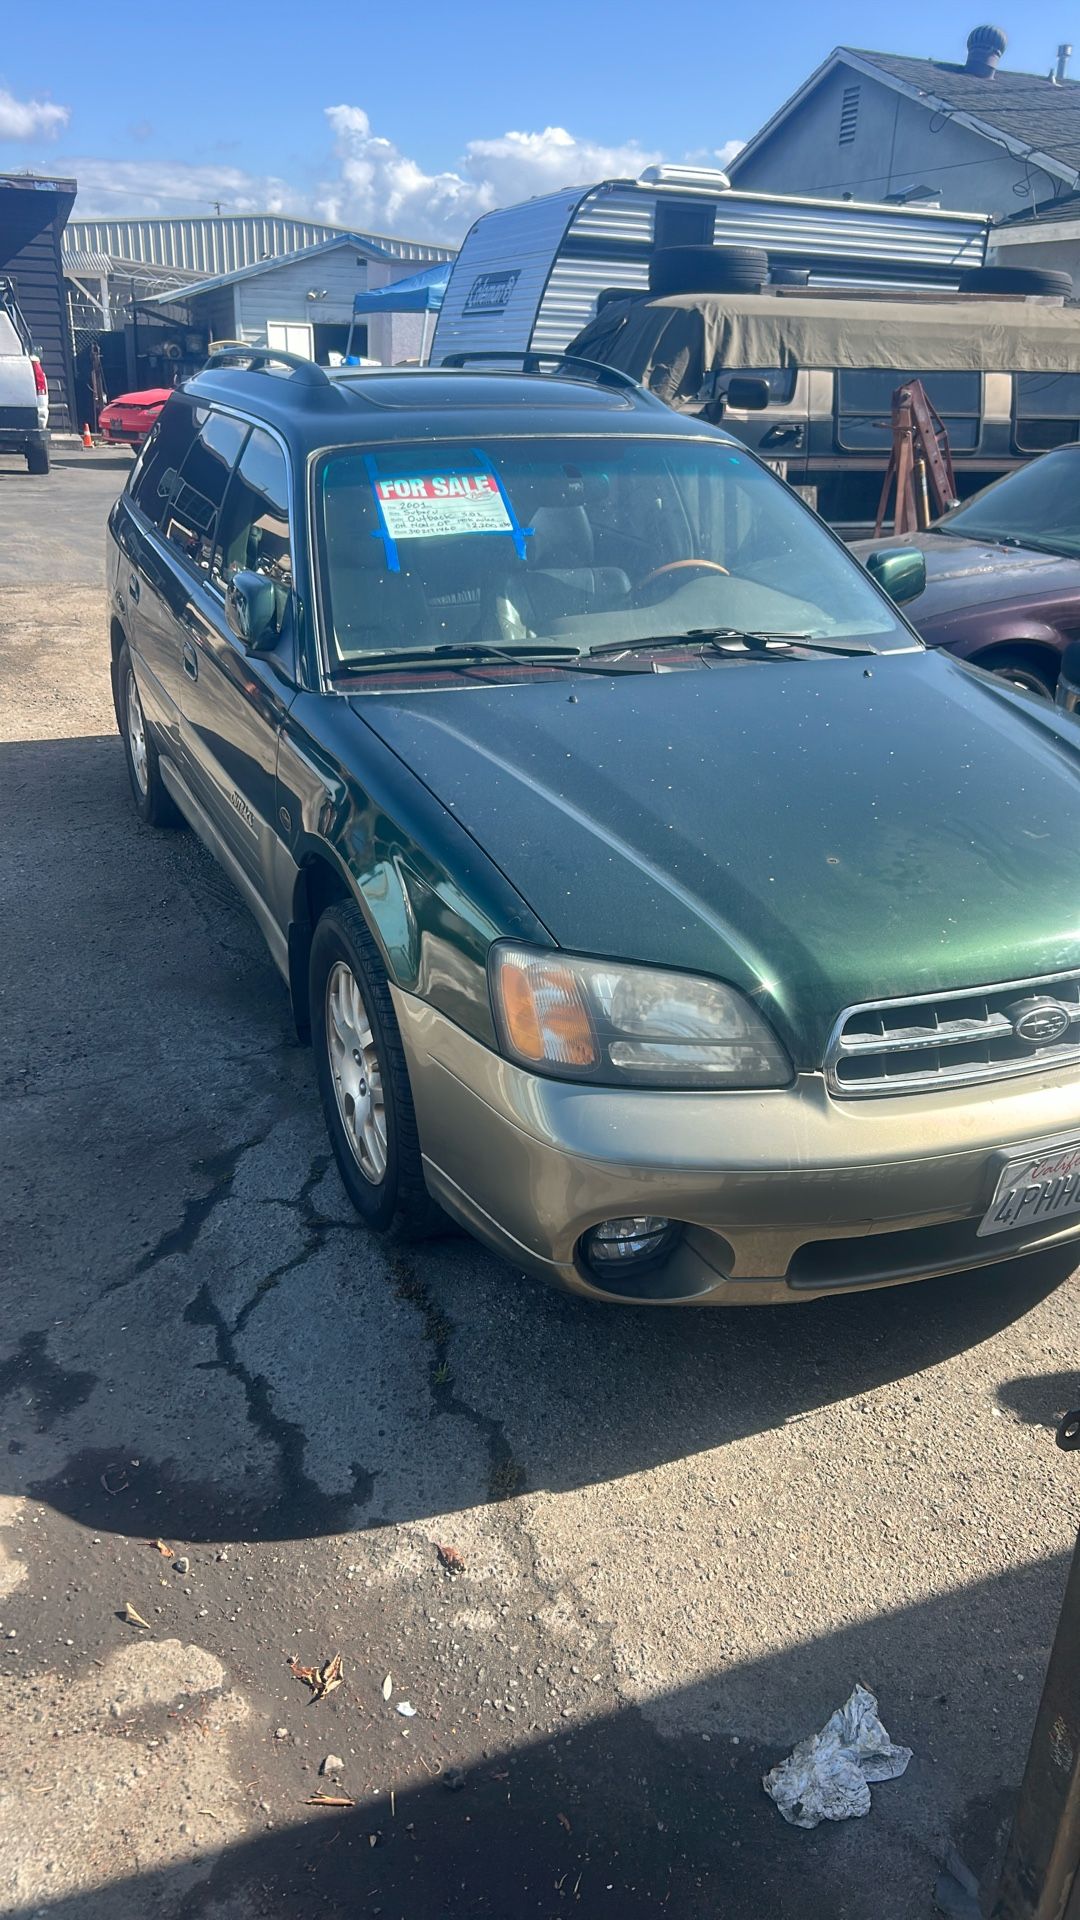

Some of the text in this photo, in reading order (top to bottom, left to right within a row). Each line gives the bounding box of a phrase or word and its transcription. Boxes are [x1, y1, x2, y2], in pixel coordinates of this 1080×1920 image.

[380, 479, 428, 498] FOR
[432, 475, 491, 497] SALE
[400, 502, 426, 510] 2001
[407, 513, 457, 523] Outback
[994, 1174, 1080, 1225] 4PHH
